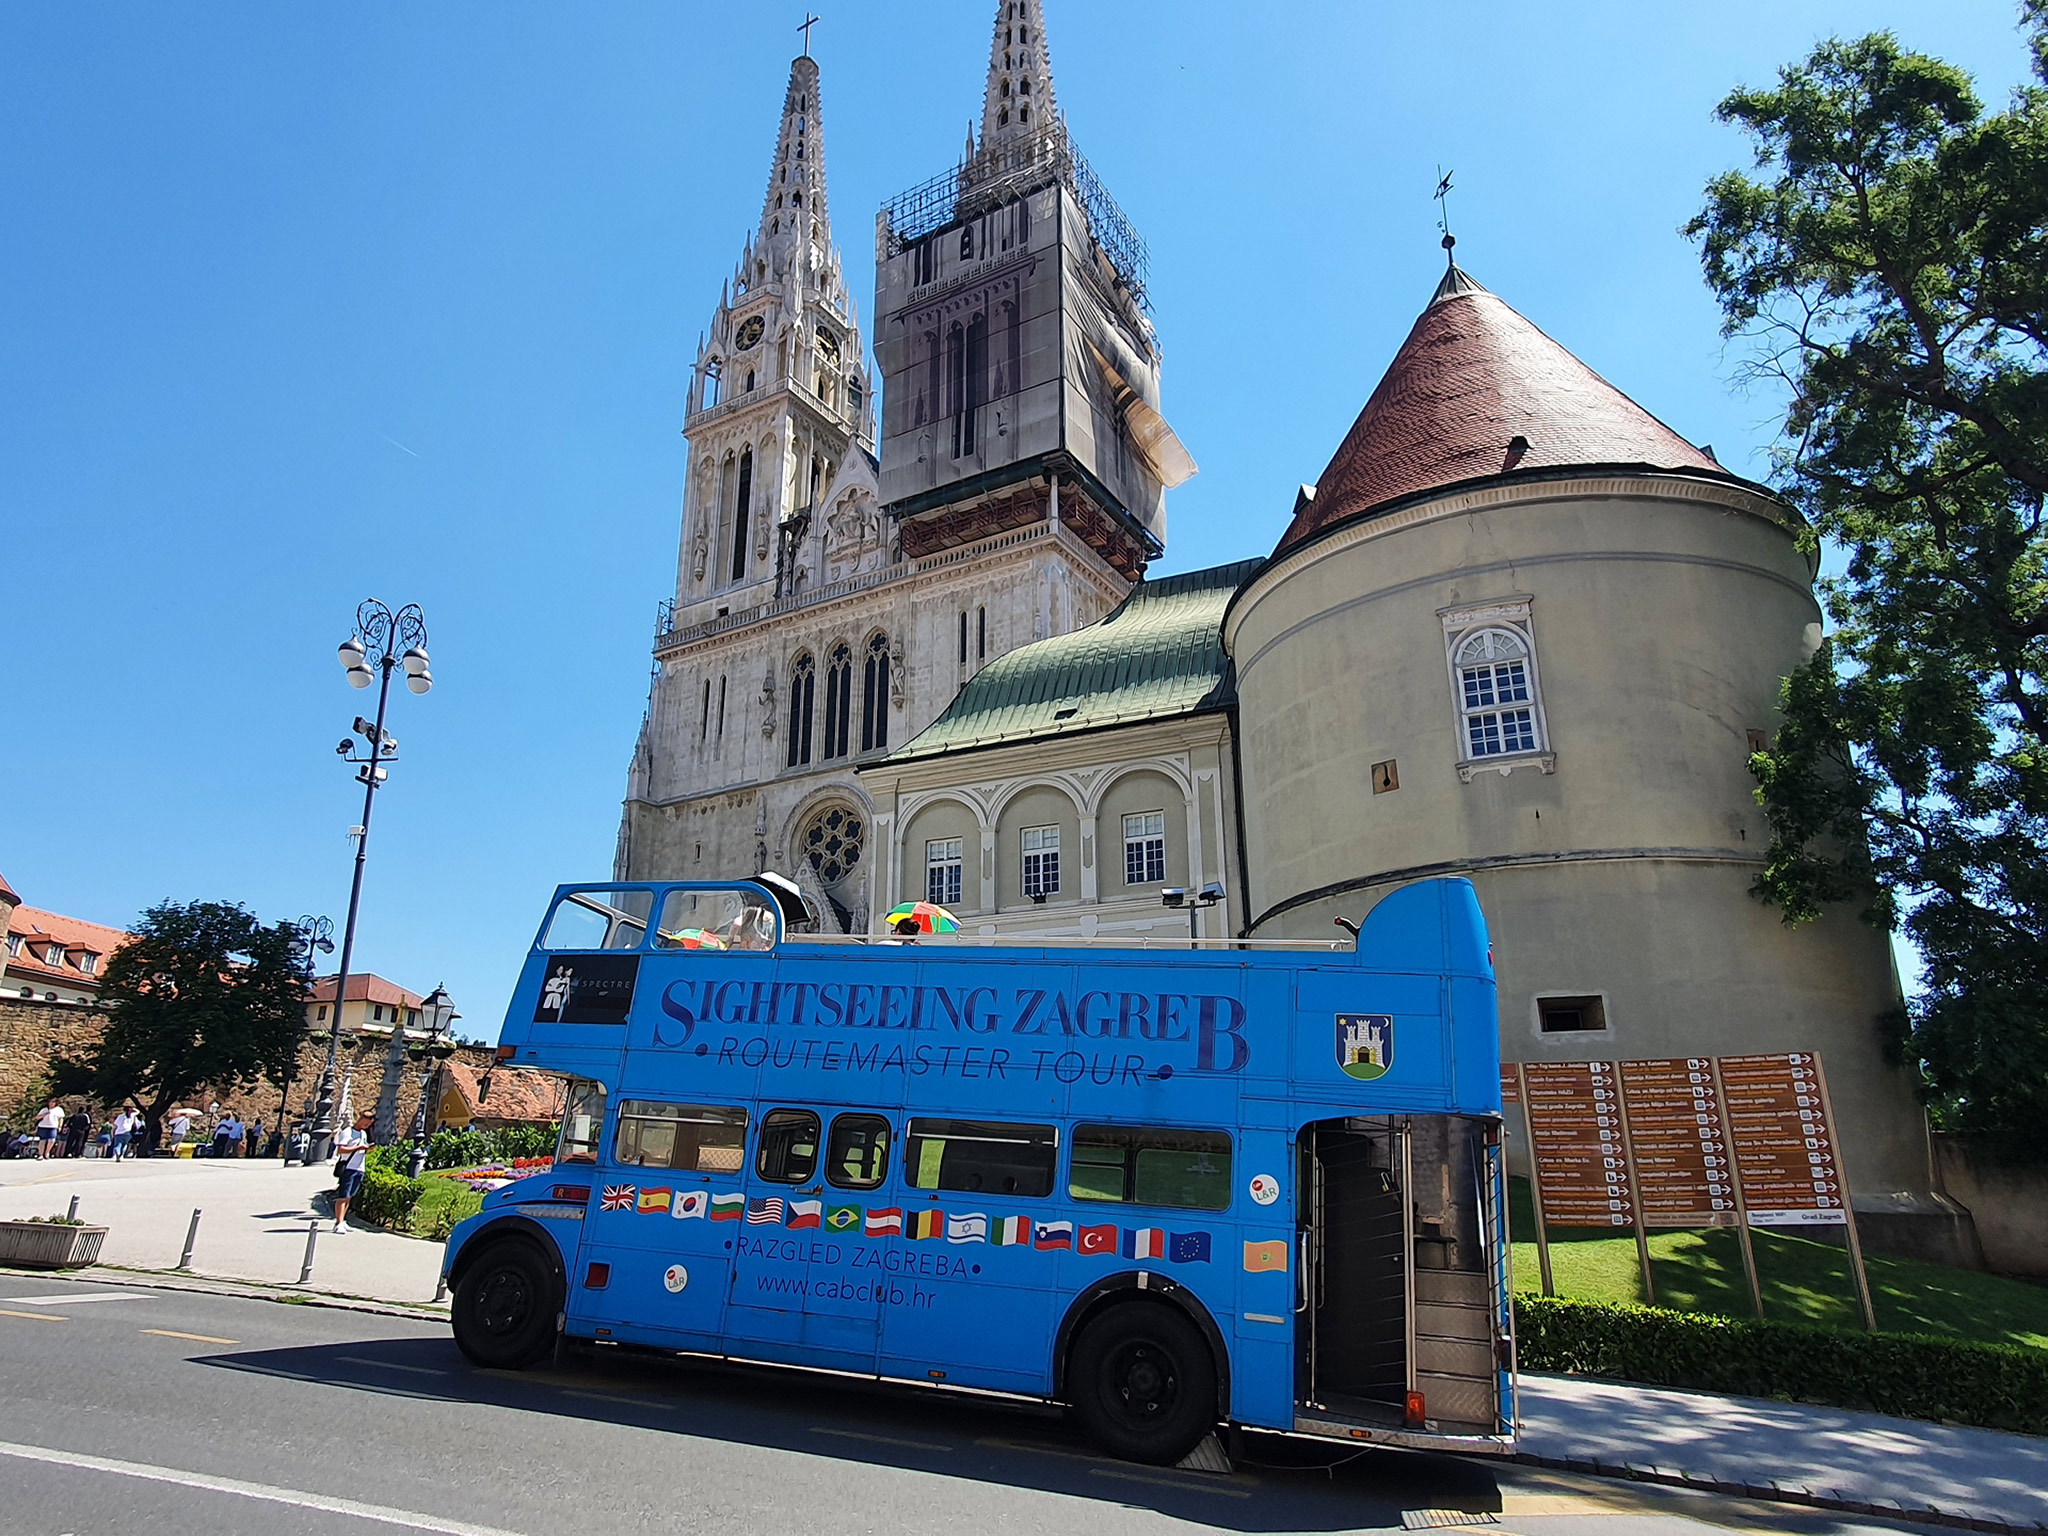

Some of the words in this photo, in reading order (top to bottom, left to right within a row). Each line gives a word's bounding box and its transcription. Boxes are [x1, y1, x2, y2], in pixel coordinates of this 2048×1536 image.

[582, 980, 631, 989] SPECTRE
[652, 979, 1002, 1049] SIGHTSEEING
[1011, 989, 1250, 1074] ZAGREB
[717, 1036, 1010, 1081] ROUTEMASTER
[1031, 1050, 1145, 1087] TOUR
[1255, 1187, 1277, 1201] L&R
[736, 1236, 842, 1265] RAZGLED
[851, 1246, 968, 1279] ZAGREBA
[756, 1275, 936, 1309] www.cabclub.hr
